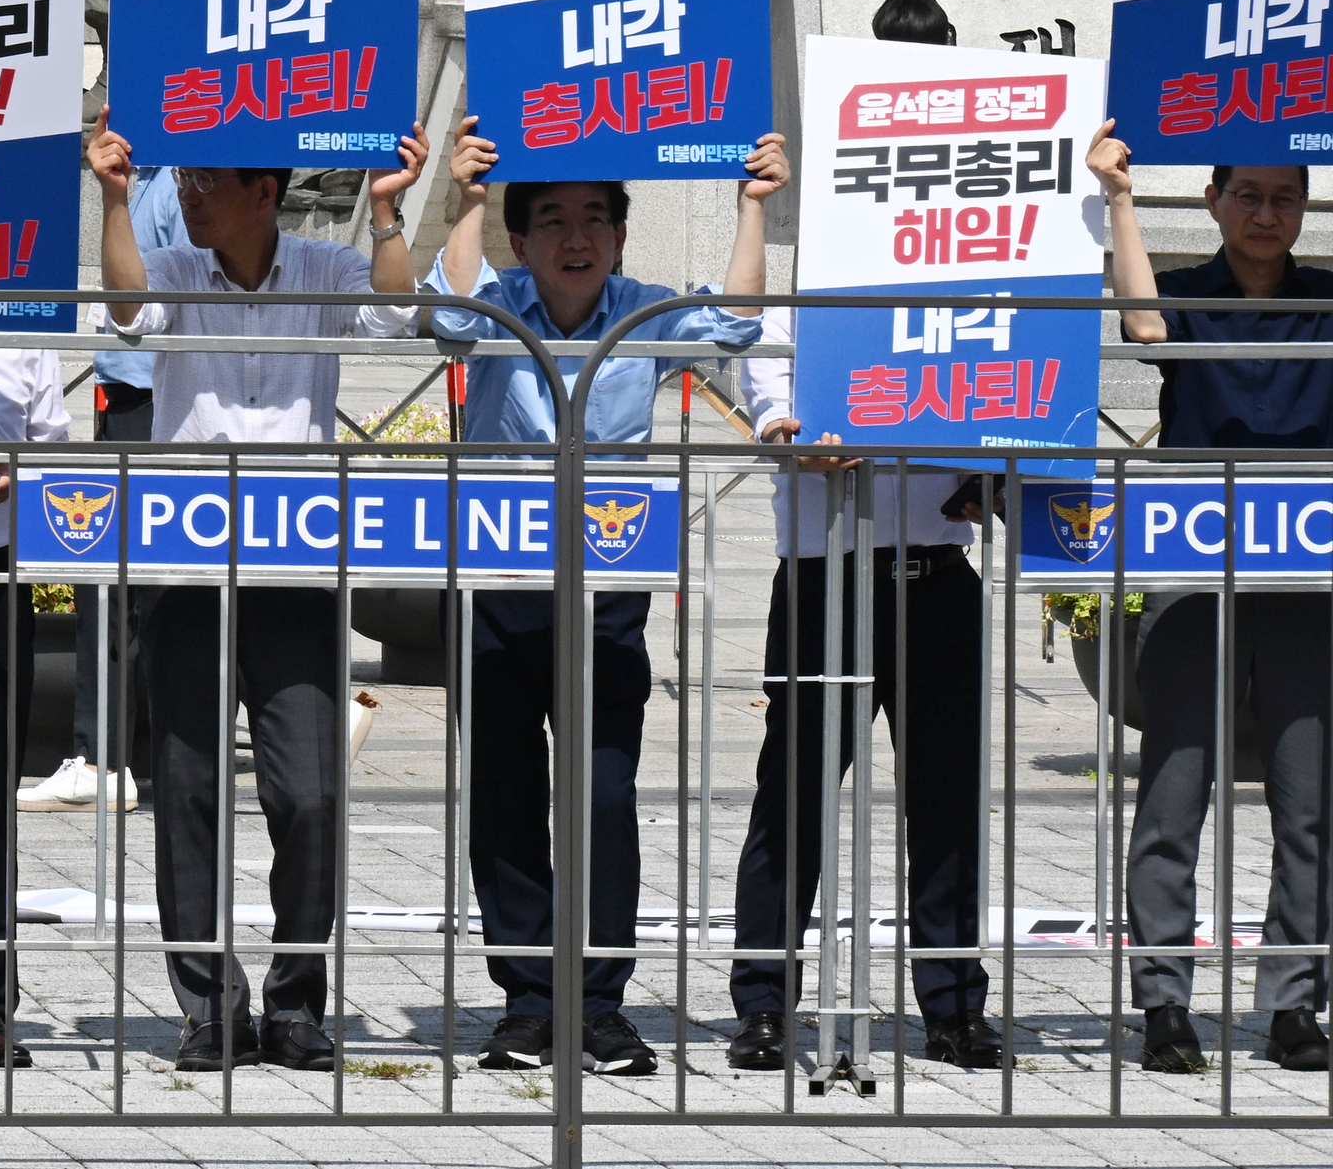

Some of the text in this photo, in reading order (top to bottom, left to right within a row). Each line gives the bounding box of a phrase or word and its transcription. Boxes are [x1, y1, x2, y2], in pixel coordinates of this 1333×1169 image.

[162, 47, 377, 132] 총사퇴!
[522, 58, 731, 148] 총사퇴!
[858, 85, 1046, 127] 윤석열 정권
[299, 132, 397, 151] 더불어민주당
[833, 137, 1073, 203] 국무총리
[893, 204, 1038, 265] 해임!
[893, 292, 1017, 353] 내각
[847, 358, 1060, 426] 총사퇴!
[63, 531, 94, 540] POLICE
[141, 493, 549, 552] POLICE LNE
[596, 539, 627, 548] POLICE
[1069, 541, 1099, 549] POLICE
